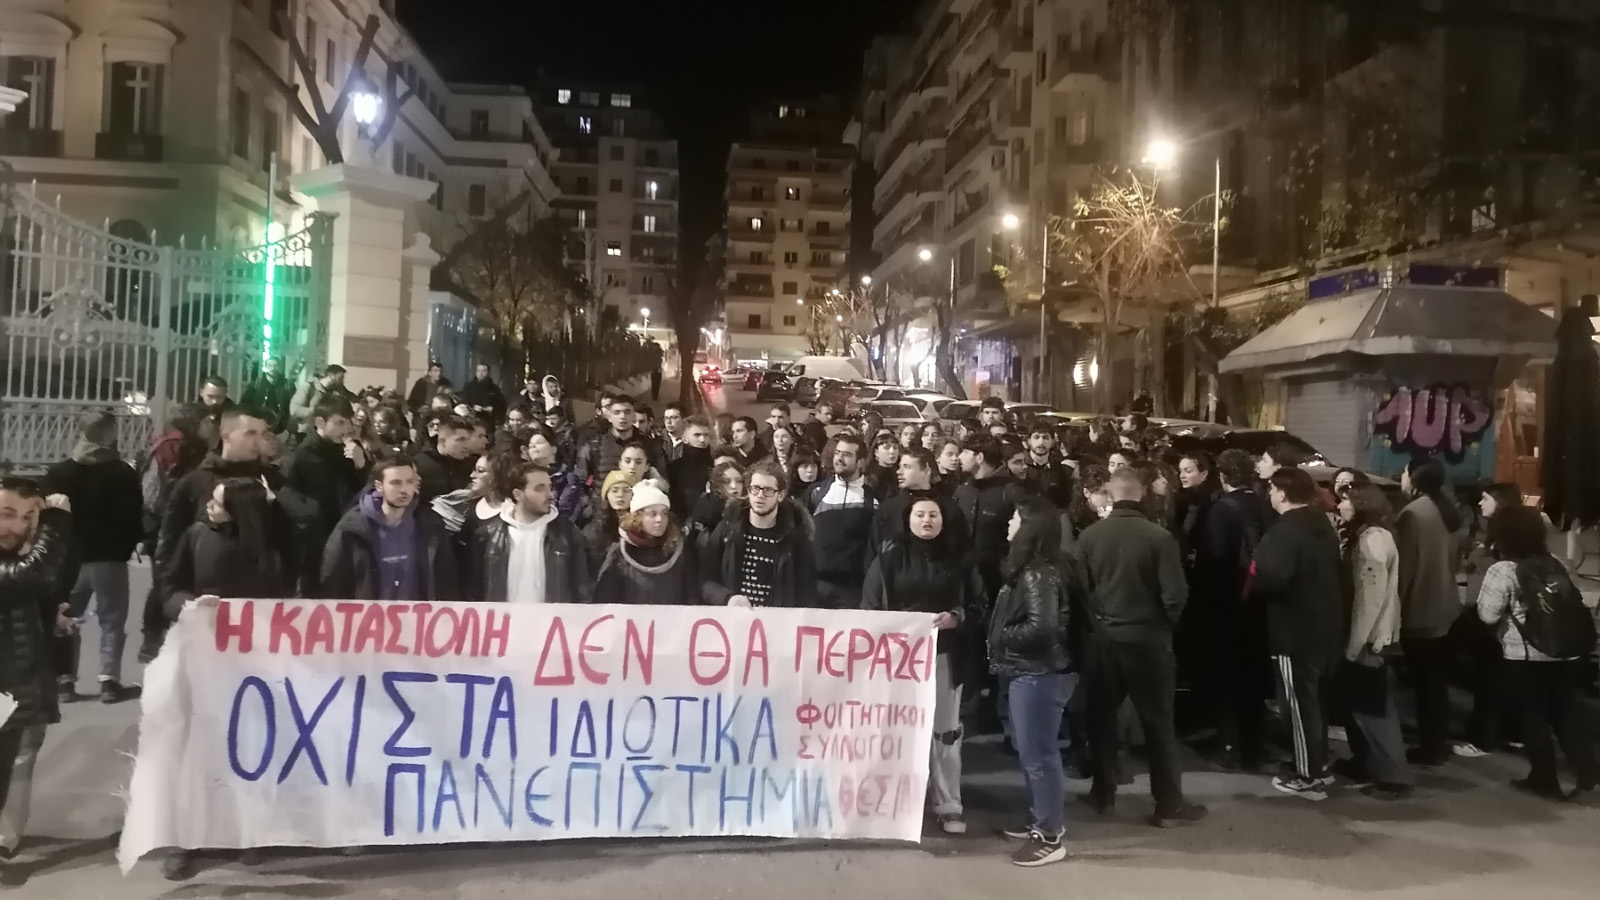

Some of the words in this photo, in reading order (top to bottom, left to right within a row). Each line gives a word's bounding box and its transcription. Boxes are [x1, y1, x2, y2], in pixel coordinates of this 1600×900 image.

[215, 600, 254, 652] Η
[269, 602, 511, 658] ΚΑΤΑΣΤΟΛΗ
[534, 614, 655, 686] ΔΕΝ
[690, 618, 769, 687] ΘΑ
[795, 625, 933, 683] ΠΕΡΑΣΕΙ
[227, 674, 366, 786] ΟΧΙ
[382, 671, 517, 760] ΣΤΑ
[796, 697, 925, 730] ΦΟΙΤΗΤΙΚΟΙ
[797, 733, 902, 763] ΣΥΛΛΟΓΟΙ
[384, 761, 833, 837] ΠΑΝΕΠΙΣΤΗΜΙΑ
